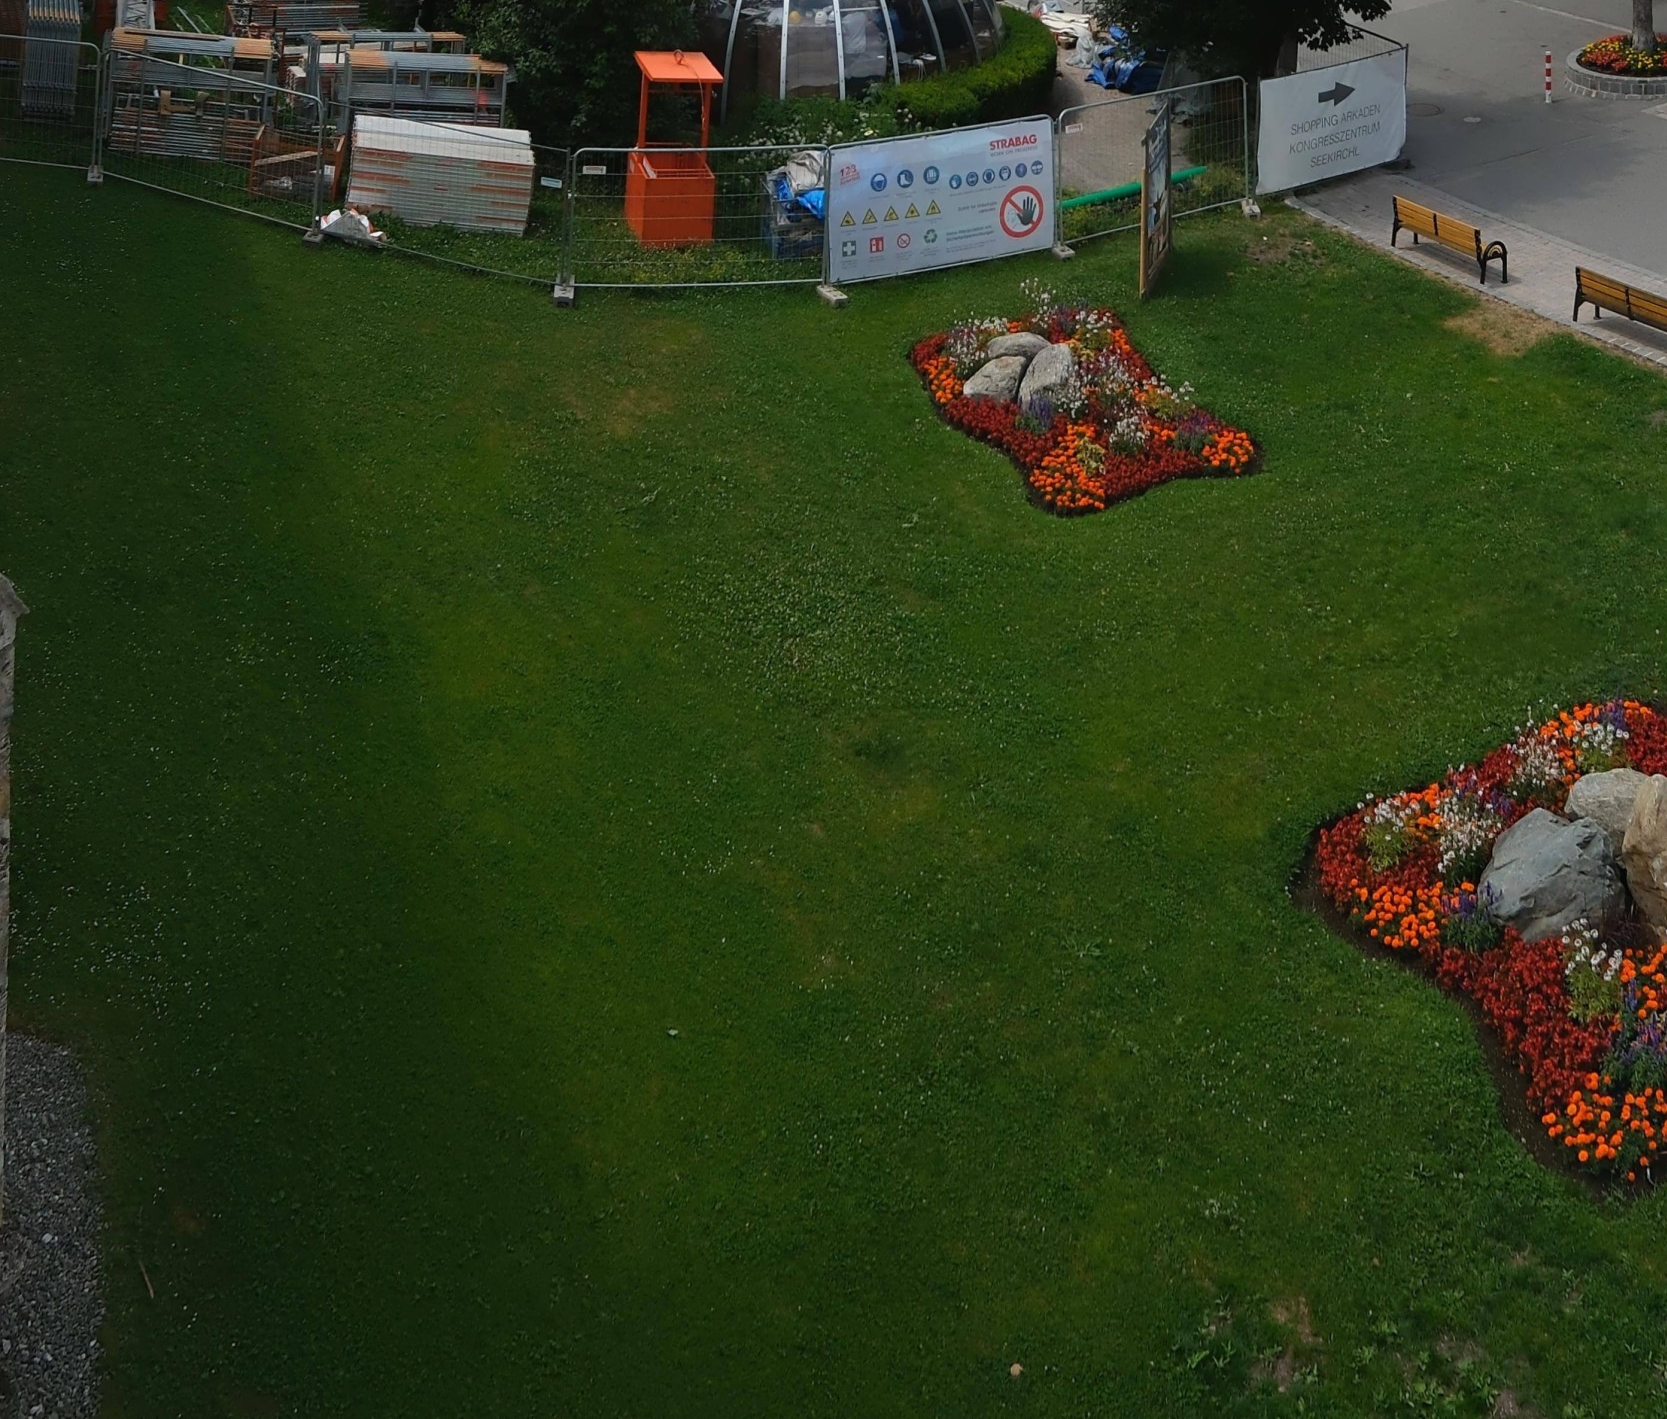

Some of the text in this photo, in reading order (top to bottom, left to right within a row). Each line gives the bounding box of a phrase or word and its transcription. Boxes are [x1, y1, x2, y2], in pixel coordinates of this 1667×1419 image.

[1290, 104, 1381, 135] SHOPPING ARKADEN
[989, 134, 1037, 150] STRABAG
[1289, 122, 1381, 154] KONGRESSZENTRUM
[1310, 146, 1360, 168] SEEKIRCHL
